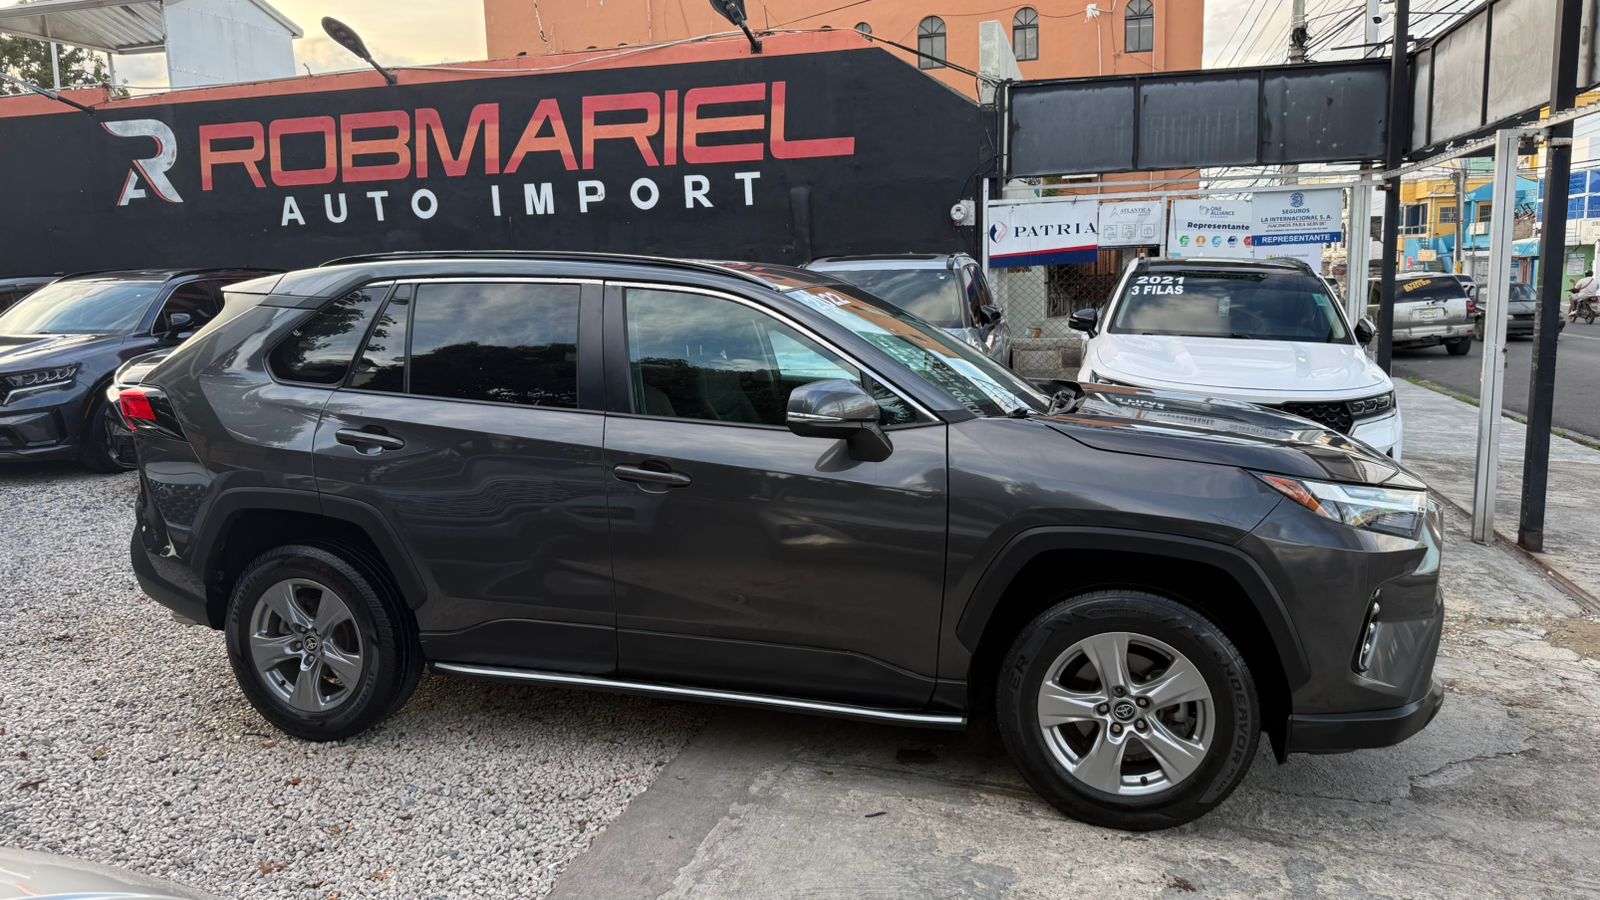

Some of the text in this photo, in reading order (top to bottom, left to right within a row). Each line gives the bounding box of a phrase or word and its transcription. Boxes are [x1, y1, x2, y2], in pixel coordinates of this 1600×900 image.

[200, 81, 855, 191] ROBMARIEL
[281, 171, 761, 226] AUTO IMPORT
[1014, 222, 1096, 237] PATRIA
[1187, 221, 1250, 230] Representante
[1261, 234, 1331, 243] REPRESENTANTE
[1136, 276, 1185, 285] 2021
[1131, 285, 1184, 295] 3 FILAS
